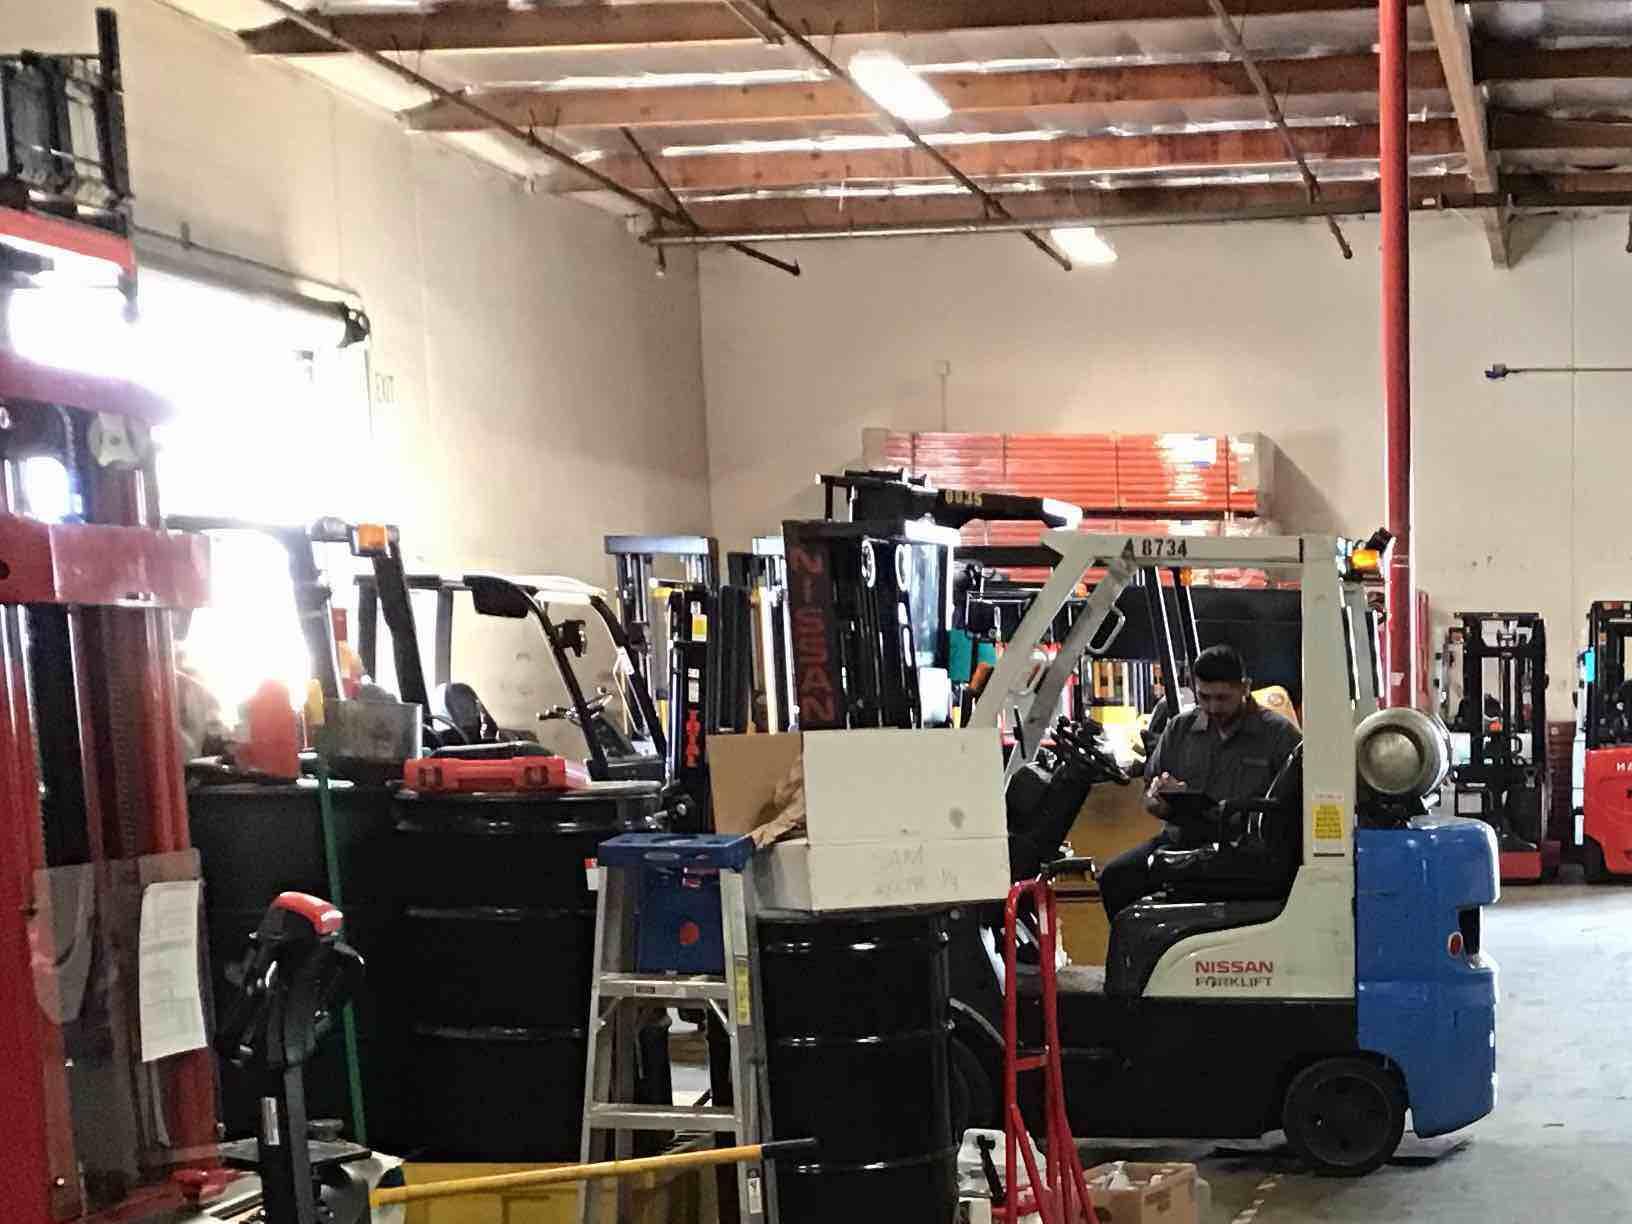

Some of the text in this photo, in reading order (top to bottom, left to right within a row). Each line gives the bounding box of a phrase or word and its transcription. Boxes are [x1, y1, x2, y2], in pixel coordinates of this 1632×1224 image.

[790, 545, 834, 720] NISSAN
[1195, 961, 1273, 973] NISSAN
[1195, 976, 1272, 987] FORKLIFT
